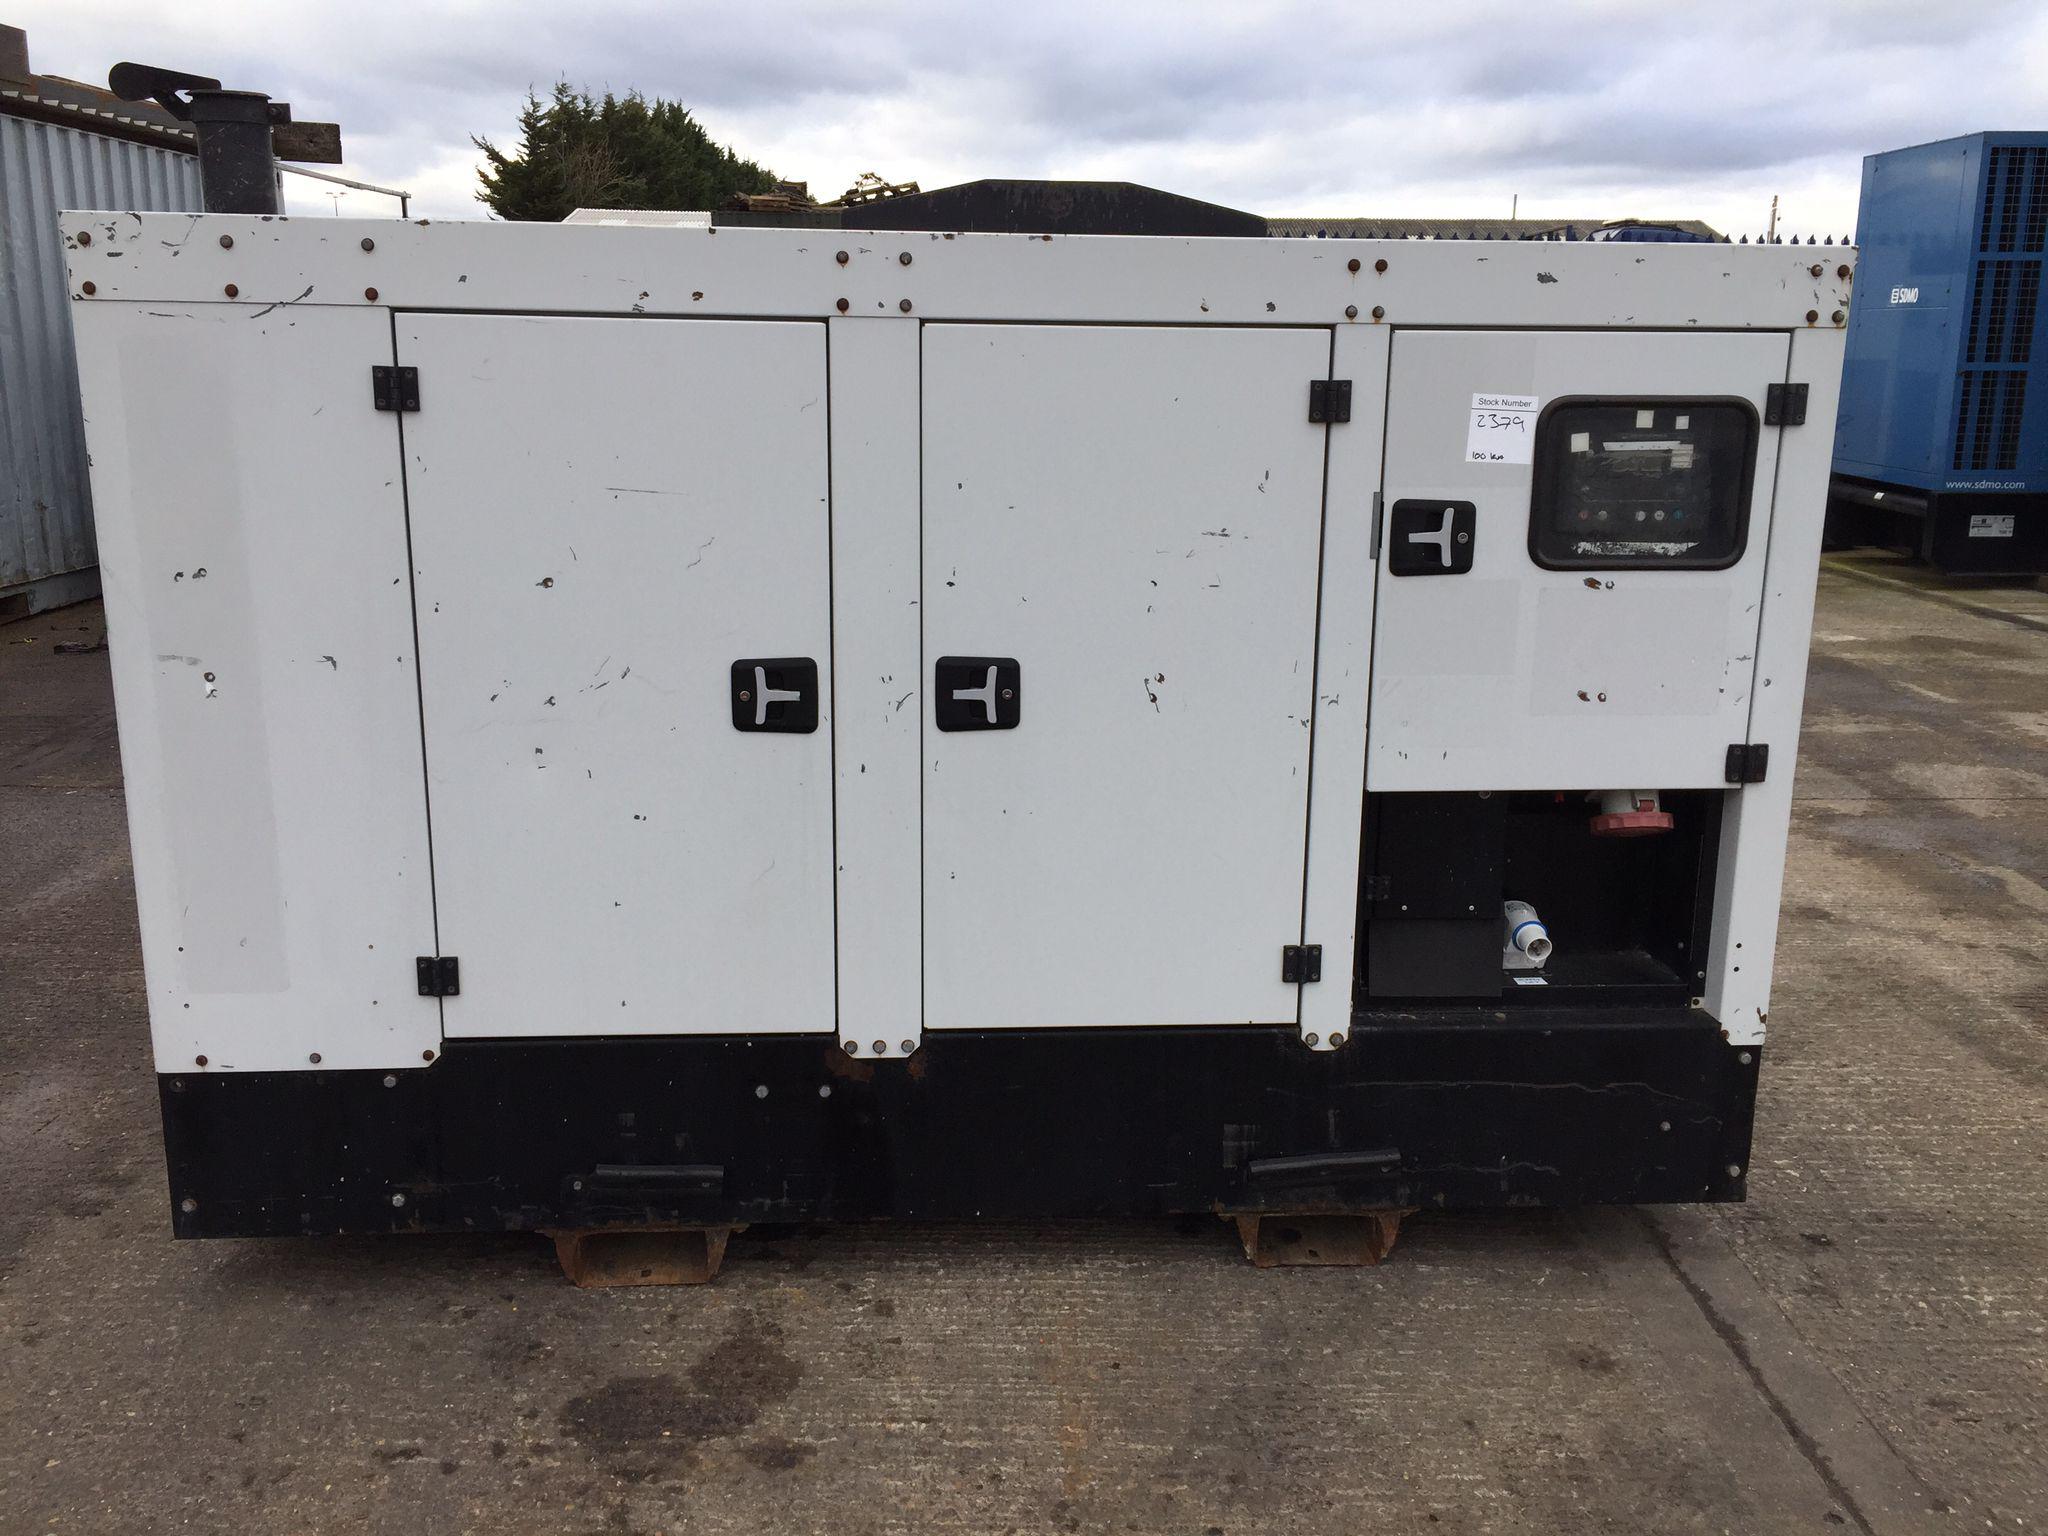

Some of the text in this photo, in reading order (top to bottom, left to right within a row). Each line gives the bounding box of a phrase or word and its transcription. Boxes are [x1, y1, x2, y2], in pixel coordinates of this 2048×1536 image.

[1478, 398, 1532, 407] Stock Number
[1477, 414, 1524, 432] 2379
[1472, 451, 1486, 460] 100
[1946, 480, 2025, 489] www.sdmo.com
